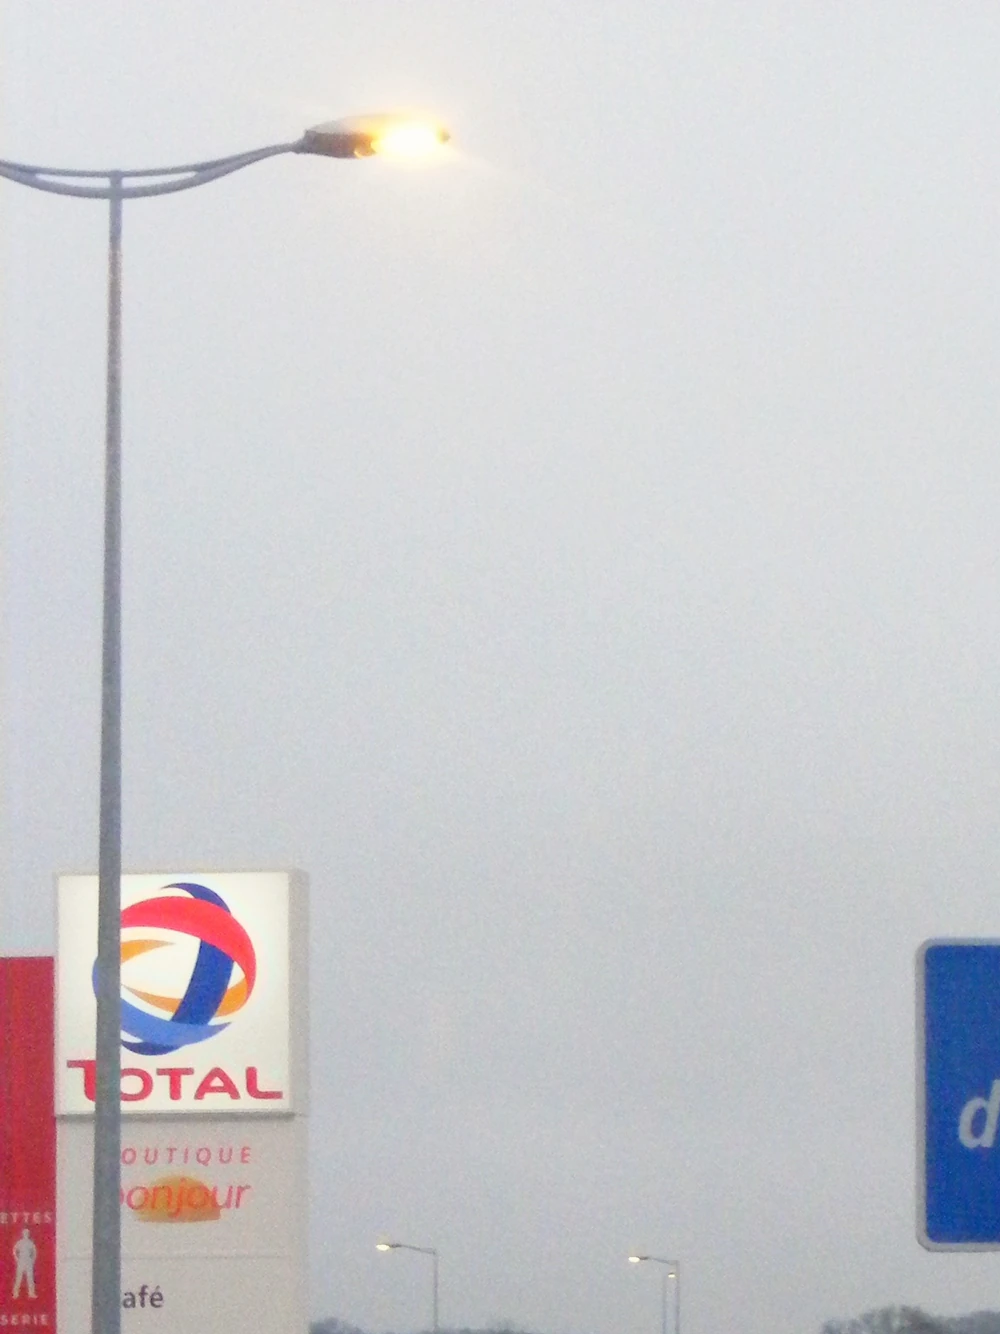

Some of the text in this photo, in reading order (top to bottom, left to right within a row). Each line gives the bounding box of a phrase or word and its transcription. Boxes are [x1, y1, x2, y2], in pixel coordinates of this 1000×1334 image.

[66, 1059, 283, 1102] TOTAL
[120, 1146, 252, 1167] OUTIQUE
[119, 1177, 252, 1218] onjour
[0, 1211, 52, 1224] ETTES
[122, 1284, 165, 1309] afé
[0, 1313, 49, 1326] SERIE
